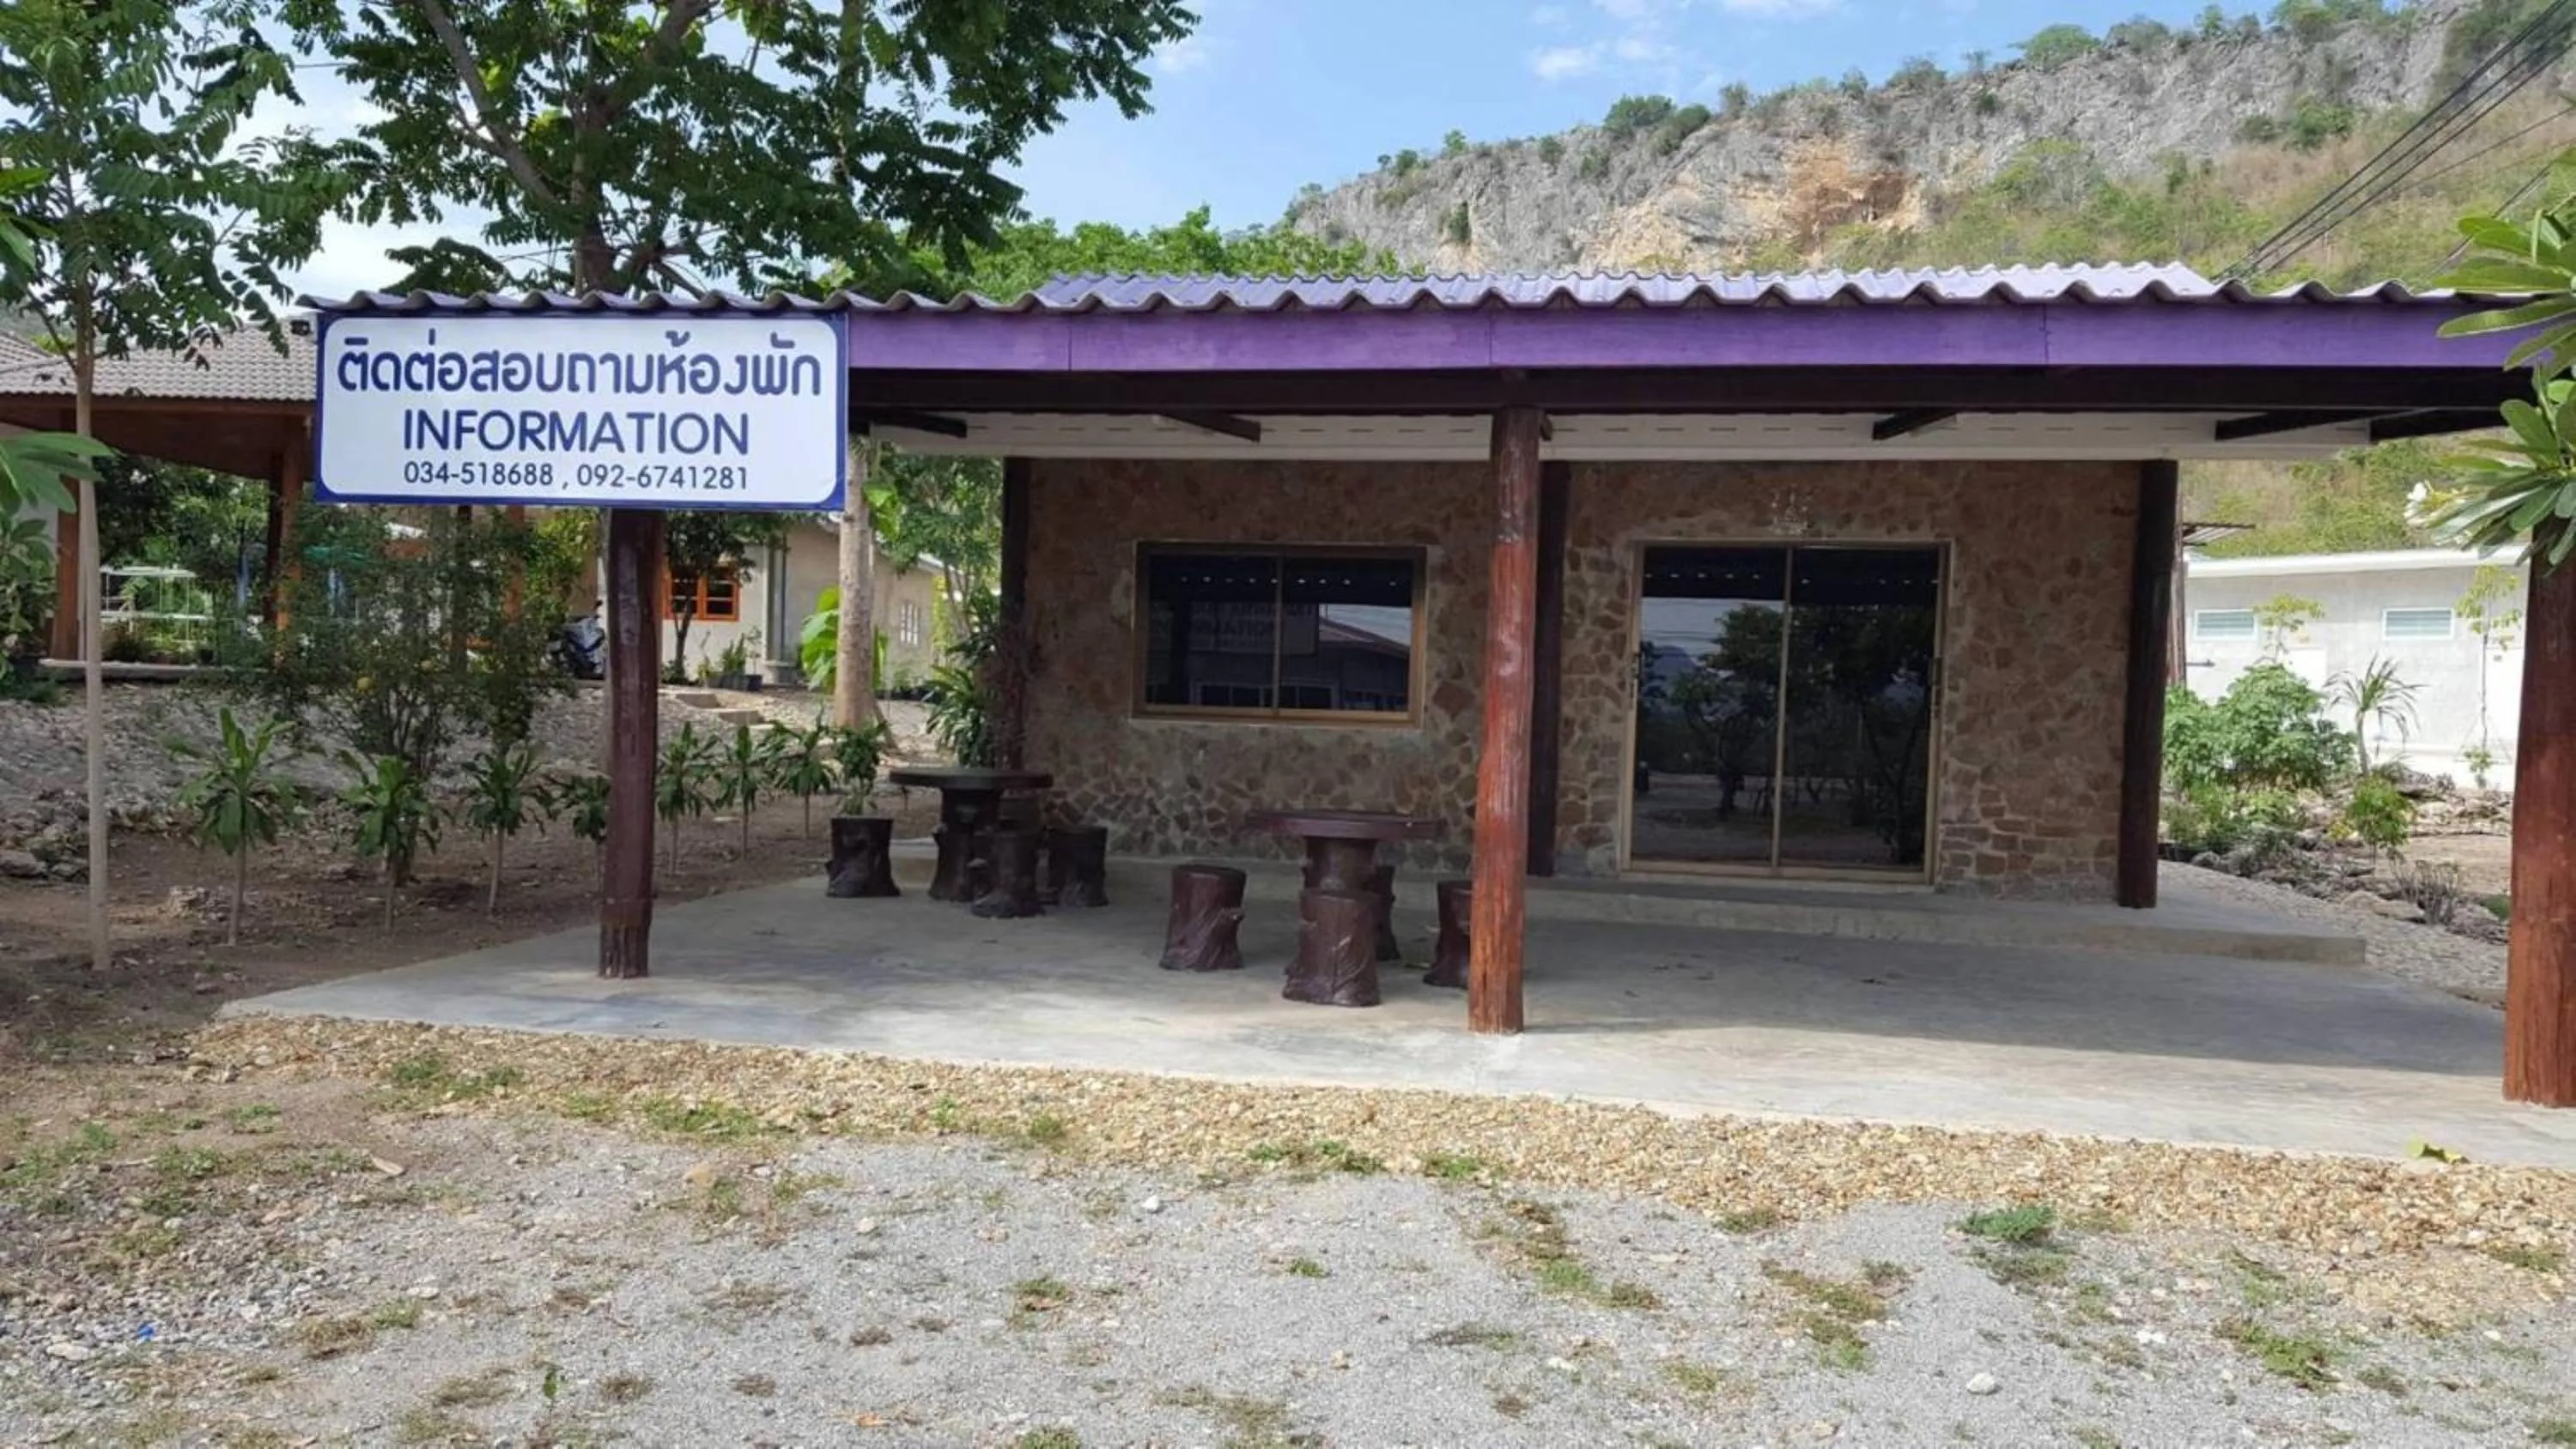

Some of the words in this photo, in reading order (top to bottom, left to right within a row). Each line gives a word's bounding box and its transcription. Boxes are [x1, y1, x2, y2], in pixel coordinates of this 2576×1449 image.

[337, 328, 821, 396] ติดต่อสอบถามห้องพัก
[404, 409, 749, 455] INFORMATION
[576, 464, 747, 489] 092-6741281
